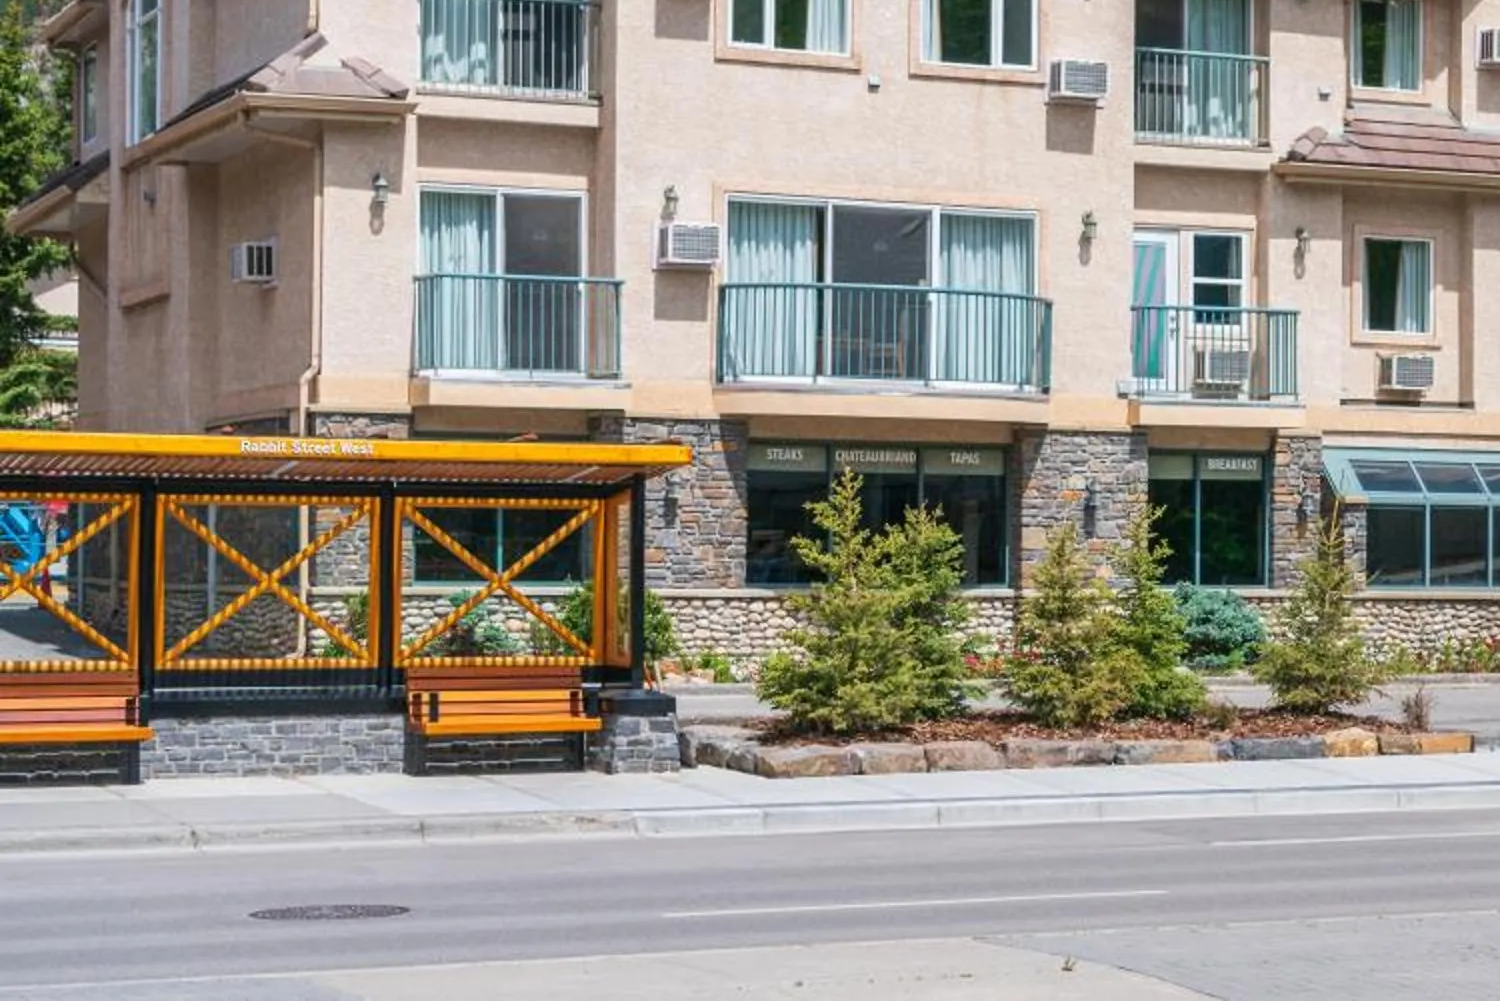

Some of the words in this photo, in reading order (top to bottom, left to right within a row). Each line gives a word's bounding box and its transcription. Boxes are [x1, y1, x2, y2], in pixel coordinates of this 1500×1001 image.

[241, 440, 286, 453] Rabbit
[292, 442, 336, 455] Street
[340, 443, 373, 456] West
[766, 448, 804, 462] STEAKS
[950, 452, 980, 465] TAPAS
